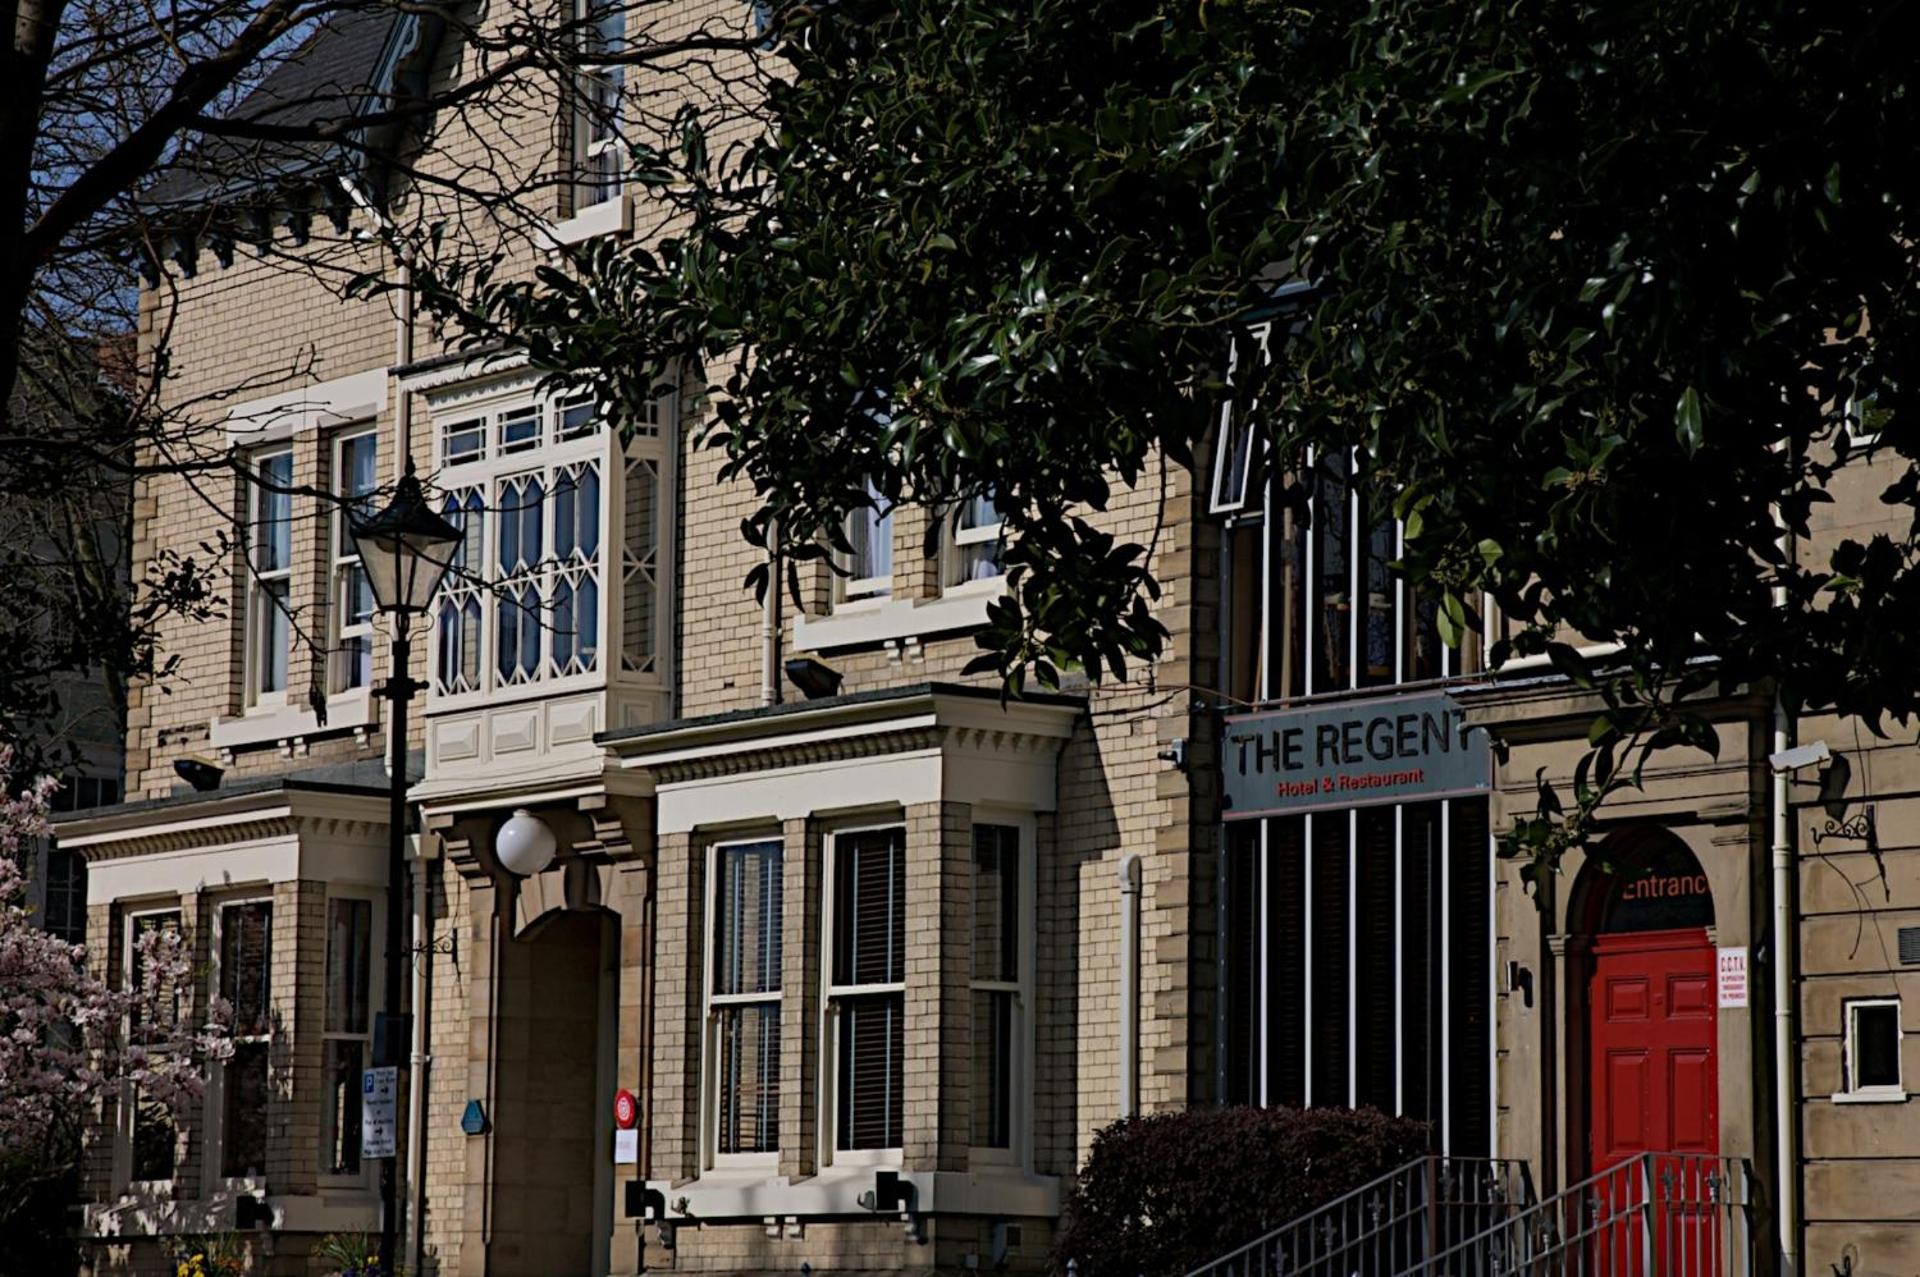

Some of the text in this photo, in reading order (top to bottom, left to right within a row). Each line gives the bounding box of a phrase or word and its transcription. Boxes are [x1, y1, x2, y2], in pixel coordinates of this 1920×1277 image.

[1231, 728, 1304, 776] THE
[1278, 769, 1425, 798] Hotel & Restaurant
